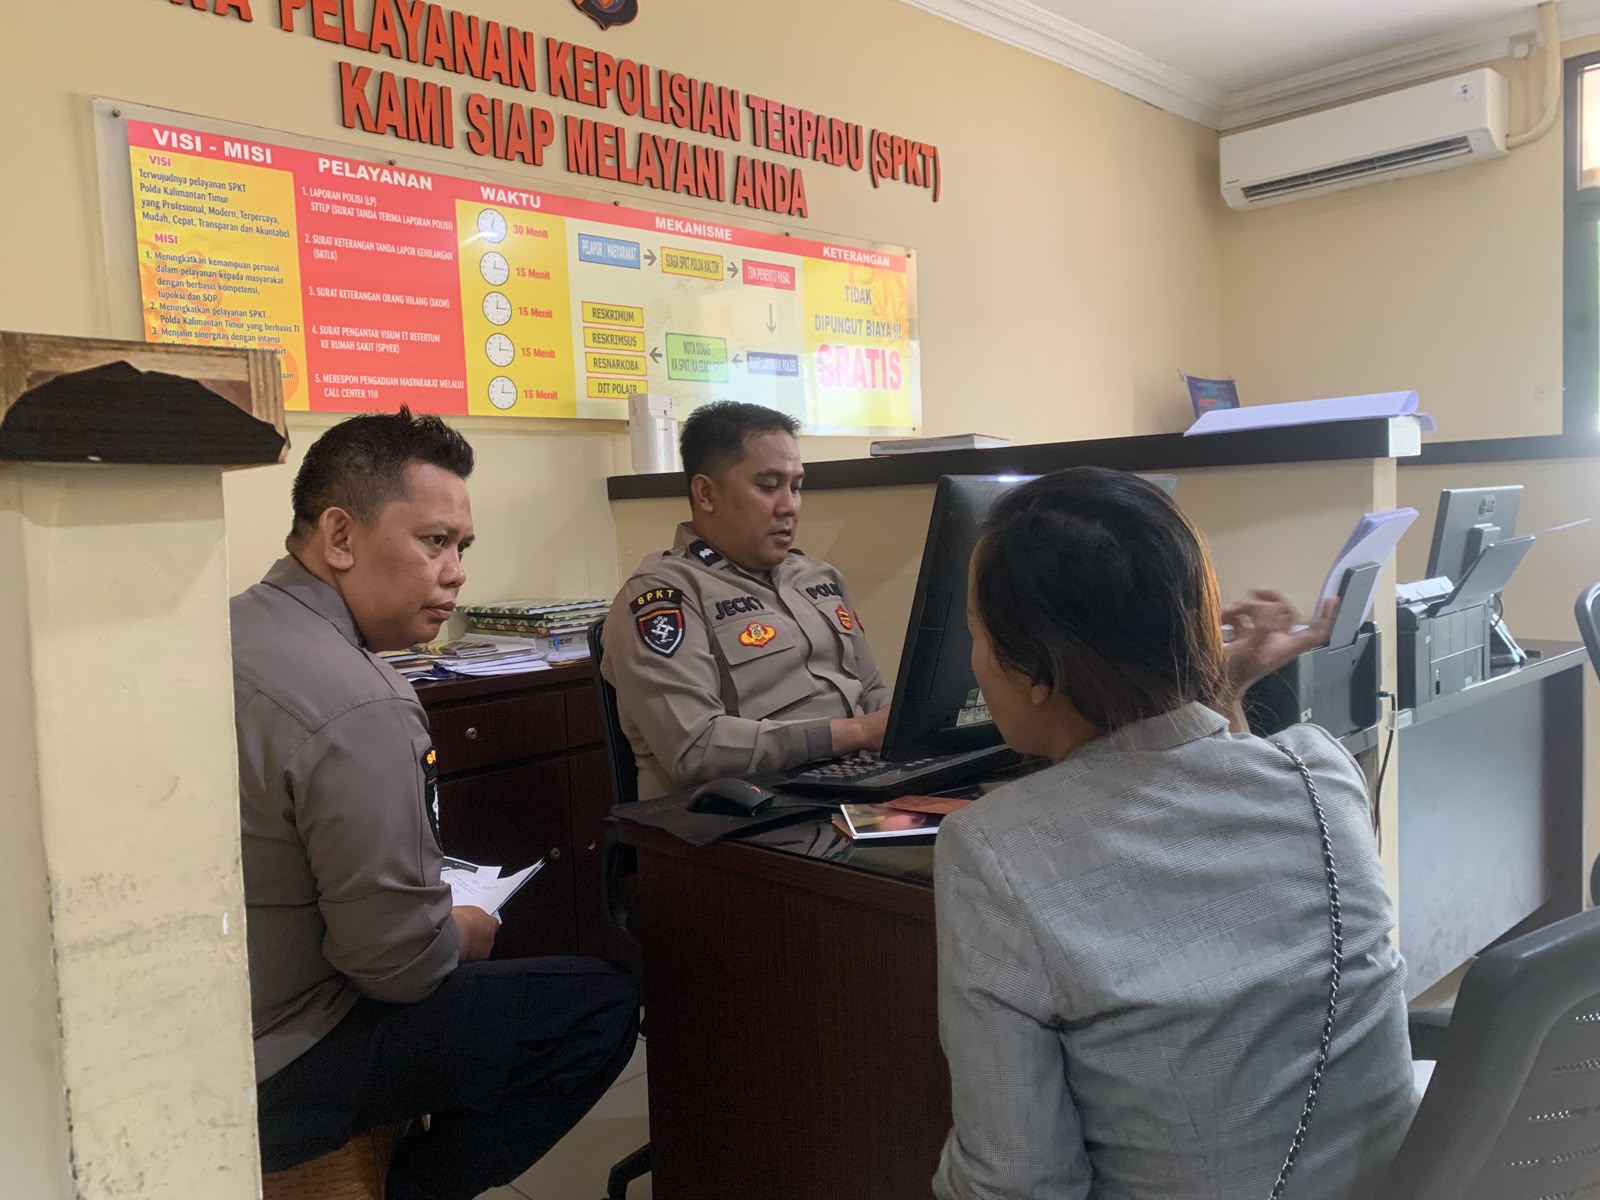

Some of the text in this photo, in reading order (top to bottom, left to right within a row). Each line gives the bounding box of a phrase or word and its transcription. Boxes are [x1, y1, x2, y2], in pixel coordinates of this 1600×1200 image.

[547, 36, 741, 141] KEPOLISIAN
[746, 94, 864, 172] TERPADU
[870, 128, 942, 202] (SPKT)
[152, 128, 202, 152] VISI
[224, 141, 272, 164] MISI
[339, 61, 809, 218] KAMI SIAP MELAYANI ANDA
[149, 155, 171, 167] VISI
[139, 169, 246, 192] Terwujudnya pelayanan SPKT
[318, 158, 432, 191] PELAYANAN
[140, 183, 228, 203] Polda Kalimantan Timur
[302, 186, 376, 207] 1. LAPORAN POLISI (LP)
[480, 186, 540, 208] WAKTU
[141, 199, 160, 210] yang
[162, 200, 206, 215] Profesional,
[142, 212, 171, 224] Mudah,
[172, 215, 196, 227] Cepat,
[198, 219, 238, 231] Transparan
[240, 224, 253, 233] dan
[311, 202, 453, 230] STTLP (SURAT TANDA TERIMA LAPORAN POLISI)
[513, 225, 548, 239] 30 Menit
[655, 217, 732, 241] MEKANISME
[154, 233, 178, 244] MISI
[305, 234, 453, 260] 2. SURAT KETERANGAN TANDA LAPOR KEHILANGAN
[581, 239, 603, 256] PELAPOR
[146, 251, 279, 272] 1. Meningkatkan kemampuan personil
[823, 246, 890, 267] KETERANGAN
[156, 265, 283, 284] dalam pelayanan kepada masyarakat
[516, 268, 550, 280] 15 Menit
[157, 278, 184, 288] dengan
[186, 280, 216, 290] berbasis
[158, 291, 218, 302] tupoksi dan SOP
[309, 286, 315, 296] 3.
[317, 287, 337, 298] SURAT
[339, 290, 381, 301] KETERANGAN
[382, 294, 404, 304] ORANG
[406, 296, 428, 306] HILANG
[845, 286, 872, 305] TIDAK
[150, 302, 266, 318] 2. Meningkatkan pelayanan SPKT
[518, 307, 553, 319] 15 Menit
[592, 307, 634, 322] RESKRIMUM
[160, 315, 180, 324] Polda
[183, 317, 222, 327] Kalimantan
[225, 320, 244, 329] Timur
[247, 323, 263, 332] yang
[264, 323, 291, 332] berbasis
[815, 314, 863, 336] DIPUNGUT
[866, 320, 891, 338] BIAYA
[152, 327, 159, 335] 3.
[161, 328, 192, 338] Menjalin
[194, 331, 229, 341] sinergitas
[231, 333, 256, 343] dengan
[312, 326, 440, 342] 4. SURAT PENGANTAR VISUM ET REFERTUM
[592, 333, 637, 347] RESKRIMSUS
[321, 340, 329, 349] KE
[331, 341, 355, 350] RUMAH
[356, 342, 375, 351] SAKIT
[521, 348, 556, 358] 15 Menit
[593, 357, 639, 371] RESNARKOBA
[816, 343, 902, 391] GRATIS
[315, 374, 464, 389] 5. MERESPON PENGADUAN MASYARAKAT MELALUI
[598, 382, 637, 395] DIT POLAIR
[324, 388, 378, 398] CALL CENTER 110
[524, 390, 558, 400] 15 Menit
[637, 589, 674, 605] SPKT
[715, 597, 765, 620] JECKY
